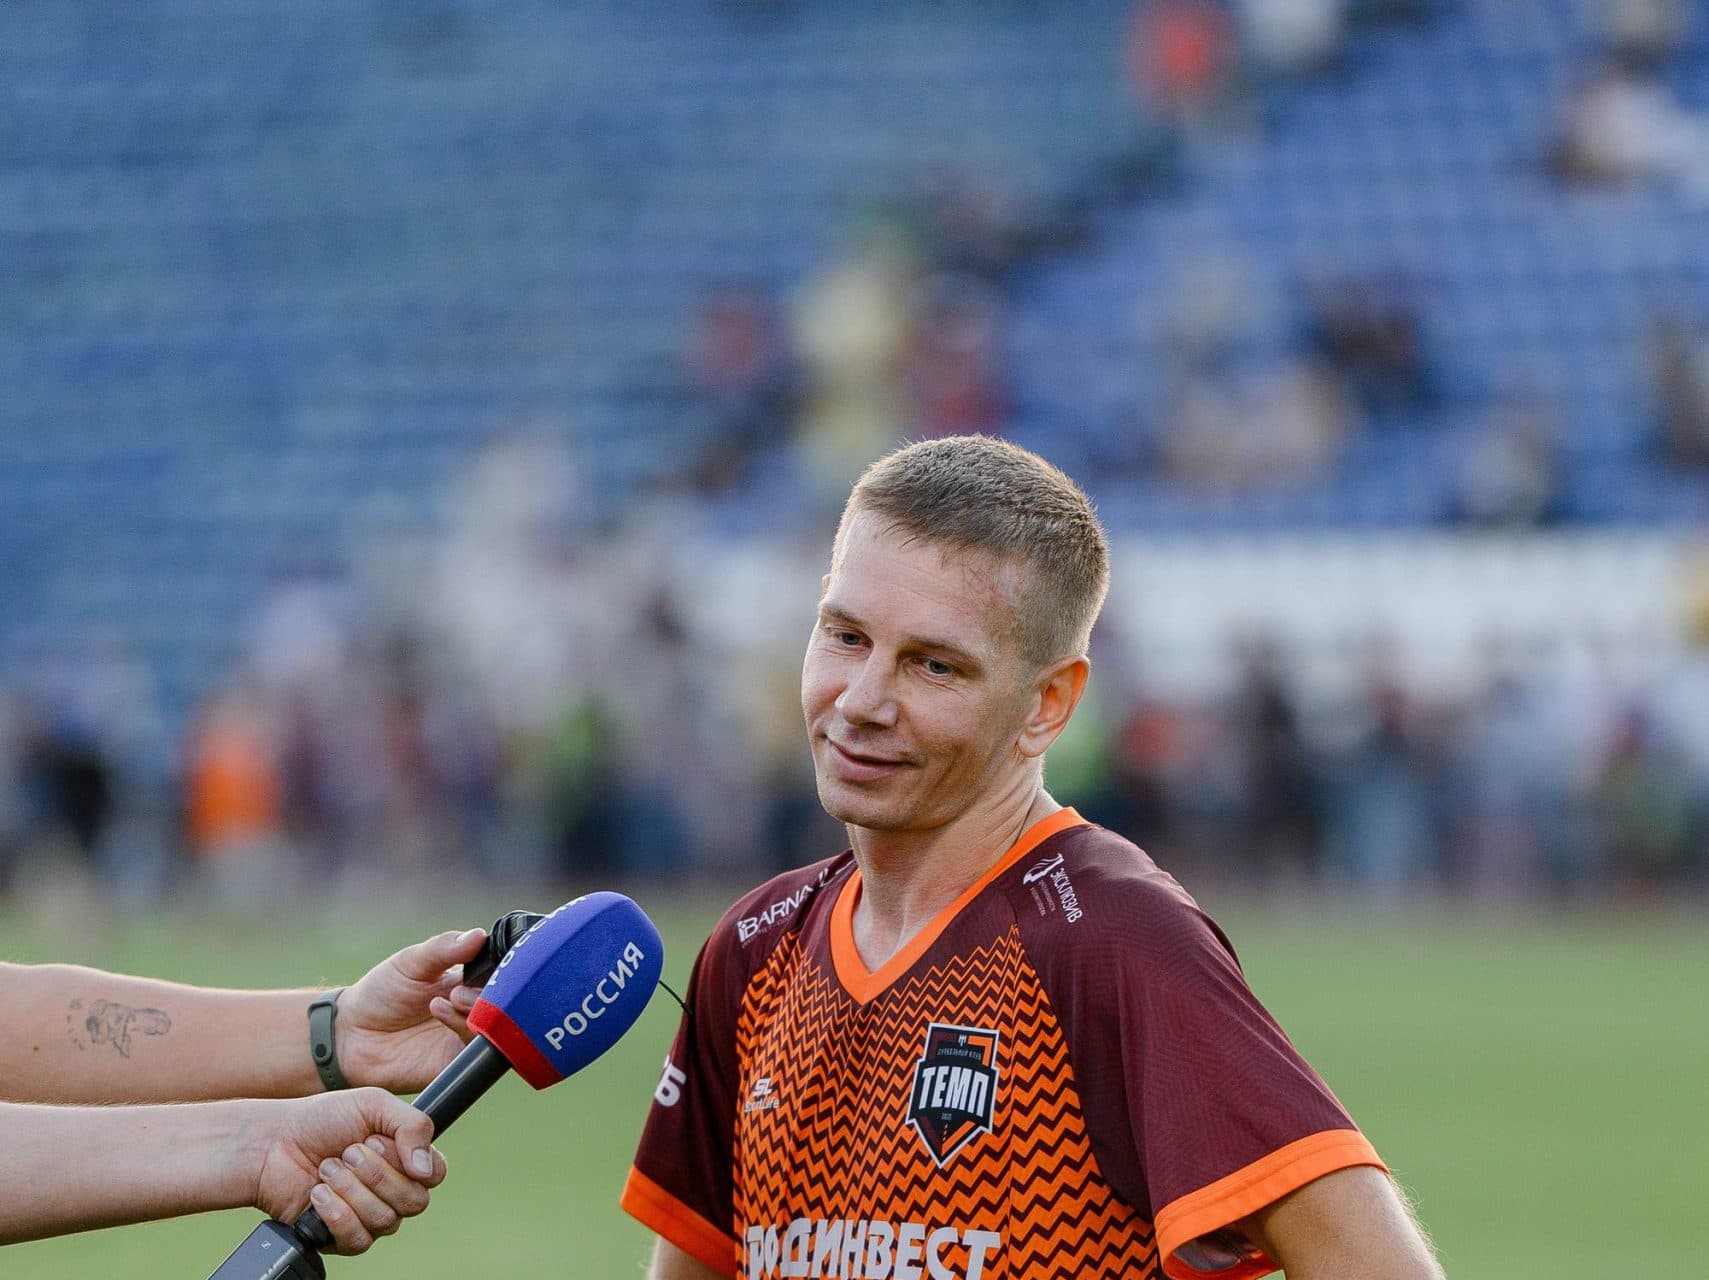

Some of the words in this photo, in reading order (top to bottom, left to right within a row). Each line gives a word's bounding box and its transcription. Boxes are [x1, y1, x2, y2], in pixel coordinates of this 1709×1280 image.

[736, 867, 829, 943] BARNA
[544, 941, 646, 1051] РОССИЯ
[918, 1065, 990, 1117] ТЕМП
